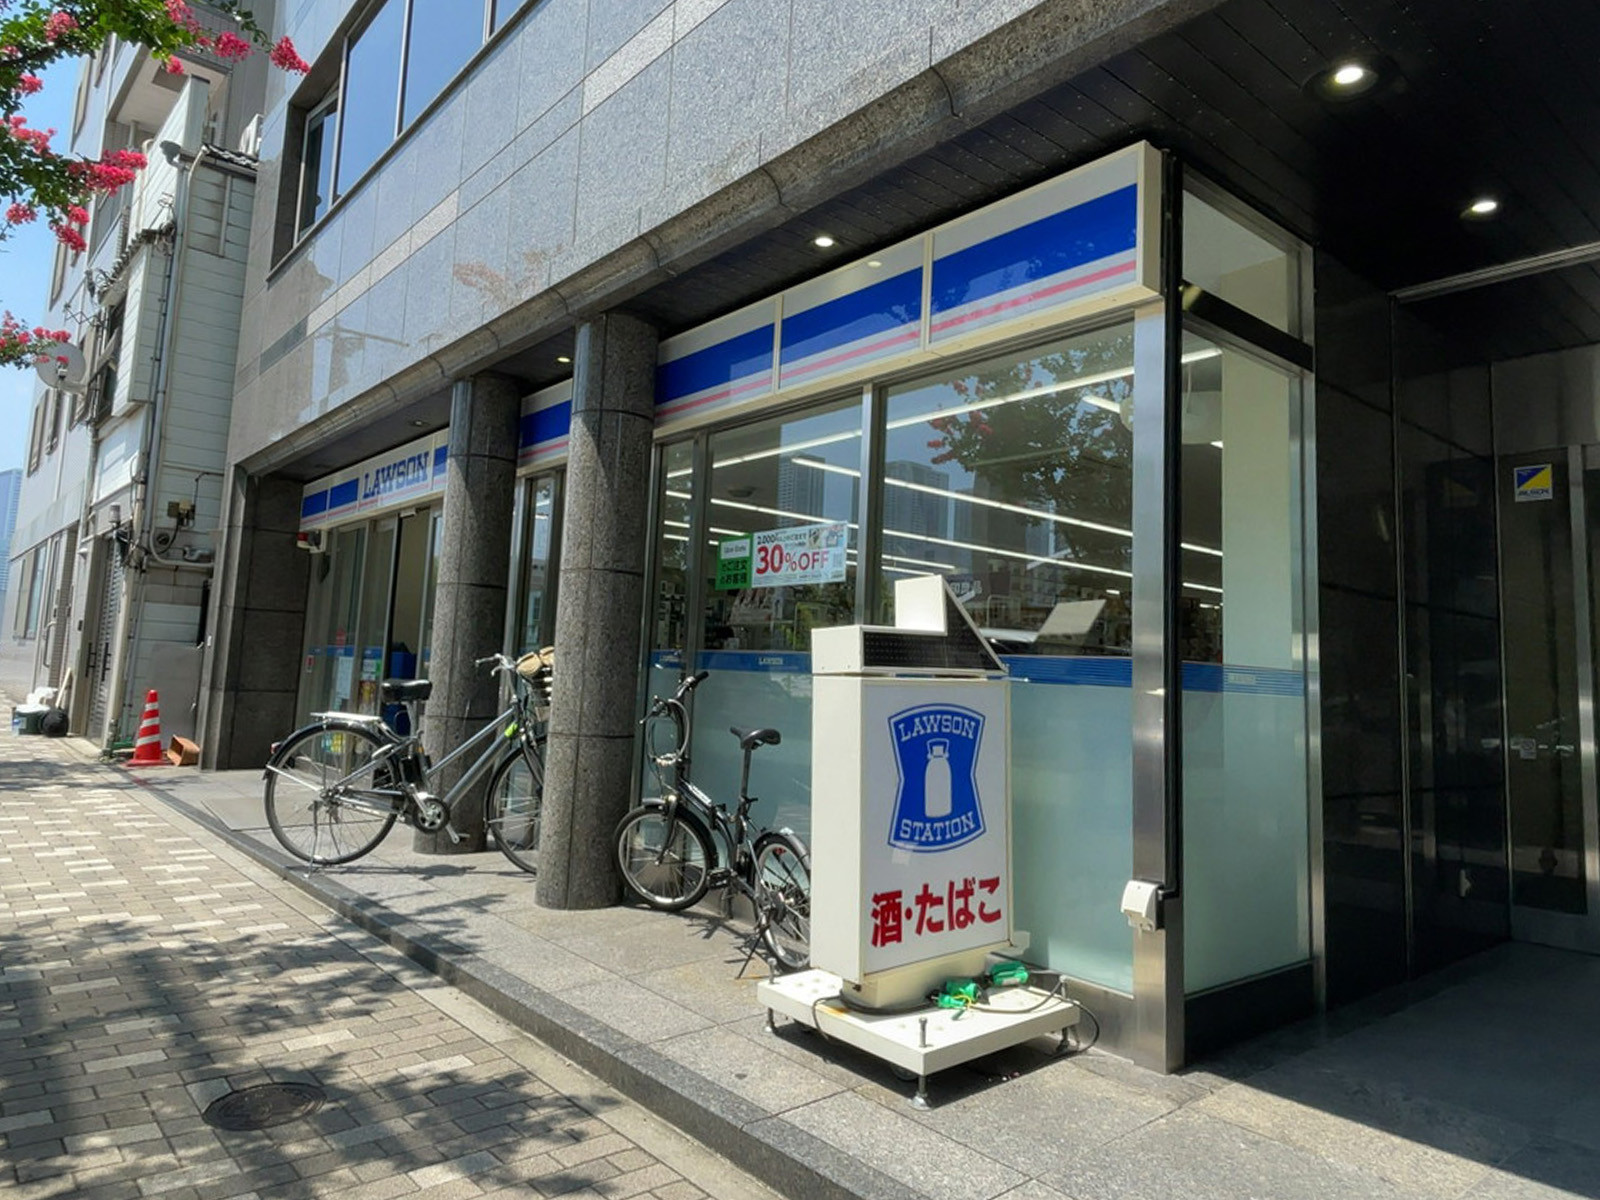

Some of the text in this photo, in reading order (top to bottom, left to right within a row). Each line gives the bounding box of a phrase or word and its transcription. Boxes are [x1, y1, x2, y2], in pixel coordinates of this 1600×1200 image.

[363, 451, 429, 499] LAWSON
[898, 714, 976, 742] LAWSON
[899, 811, 976, 841] STATION
